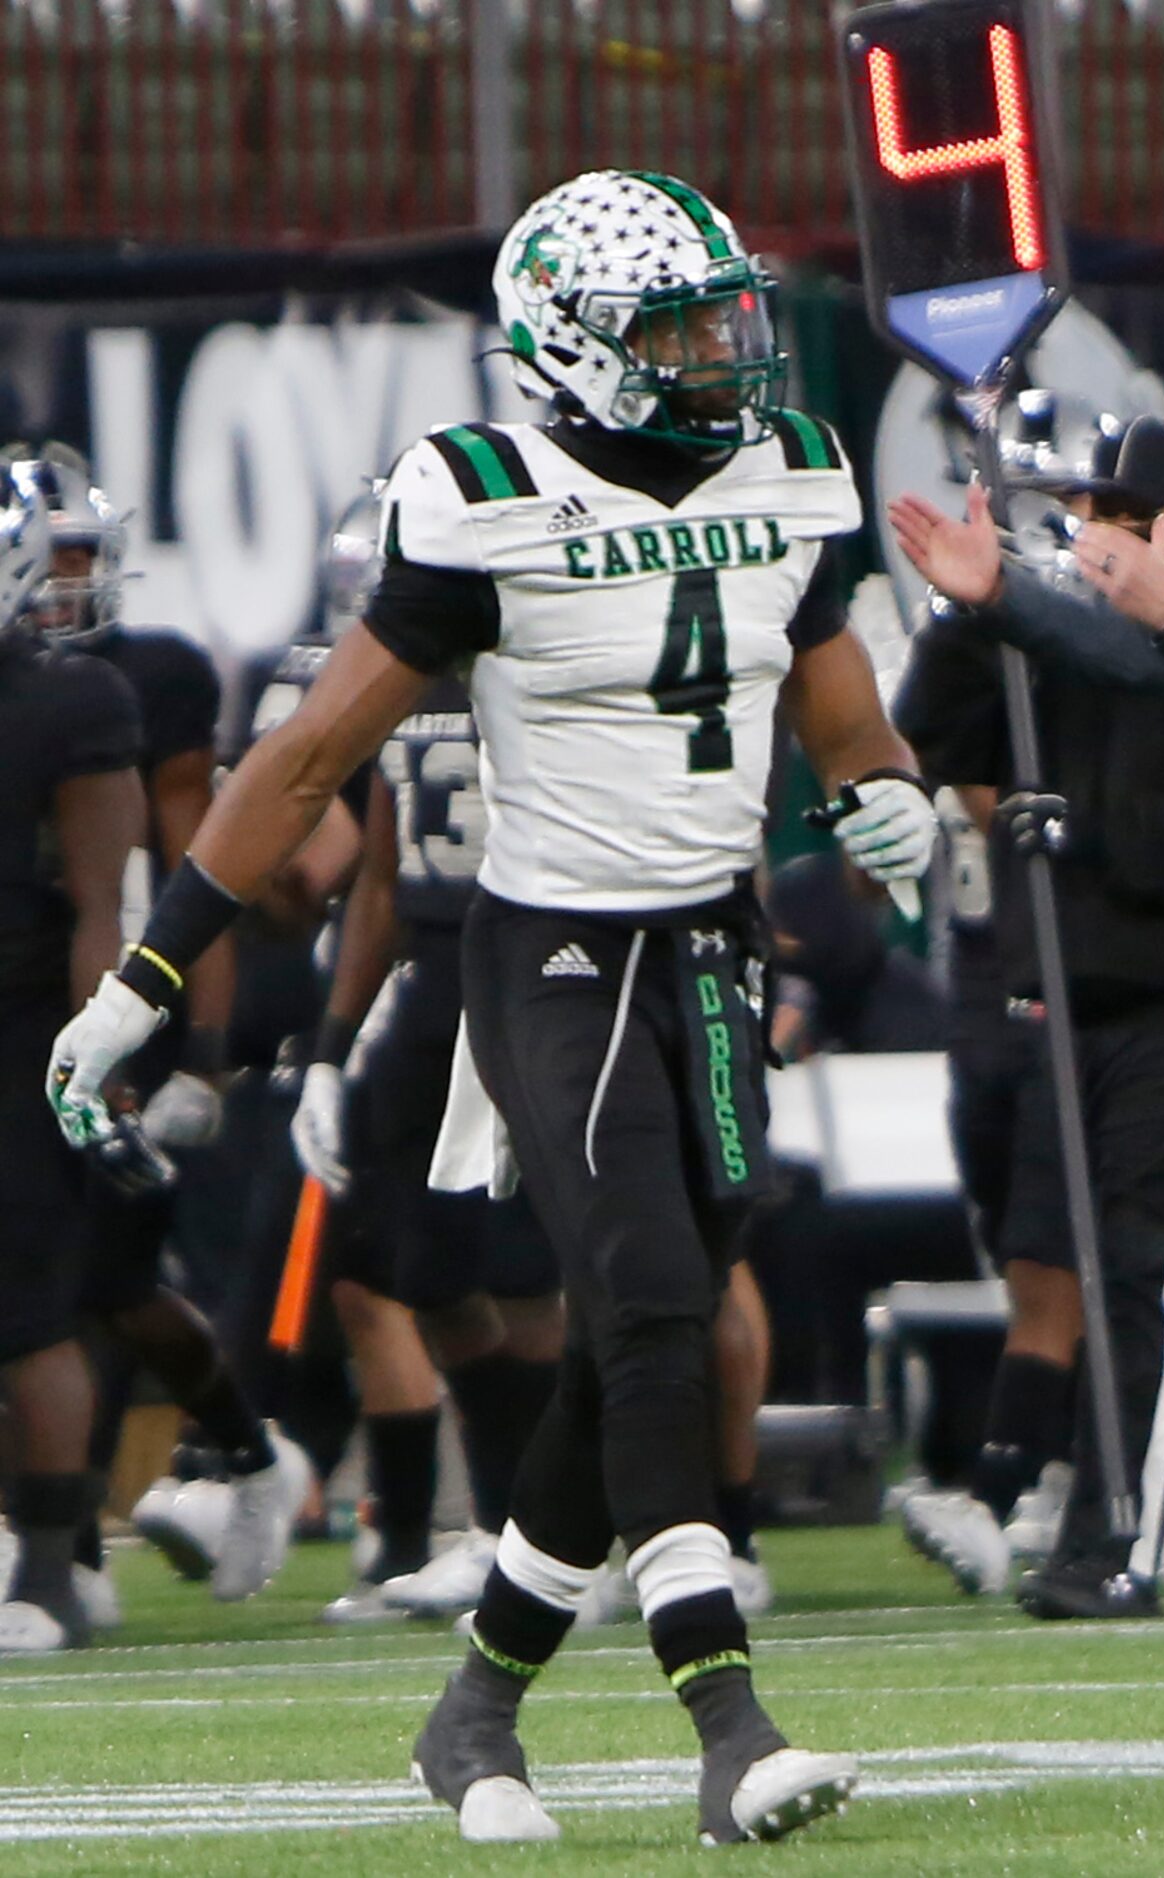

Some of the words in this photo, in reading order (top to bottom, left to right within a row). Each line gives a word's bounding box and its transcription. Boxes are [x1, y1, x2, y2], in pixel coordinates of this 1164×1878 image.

[867, 24, 1046, 270] 4
[546, 515, 599, 534] adidas
[563, 518, 788, 580] CARROLL
[645, 567, 733, 773] 4
[378, 739, 486, 877] 13
